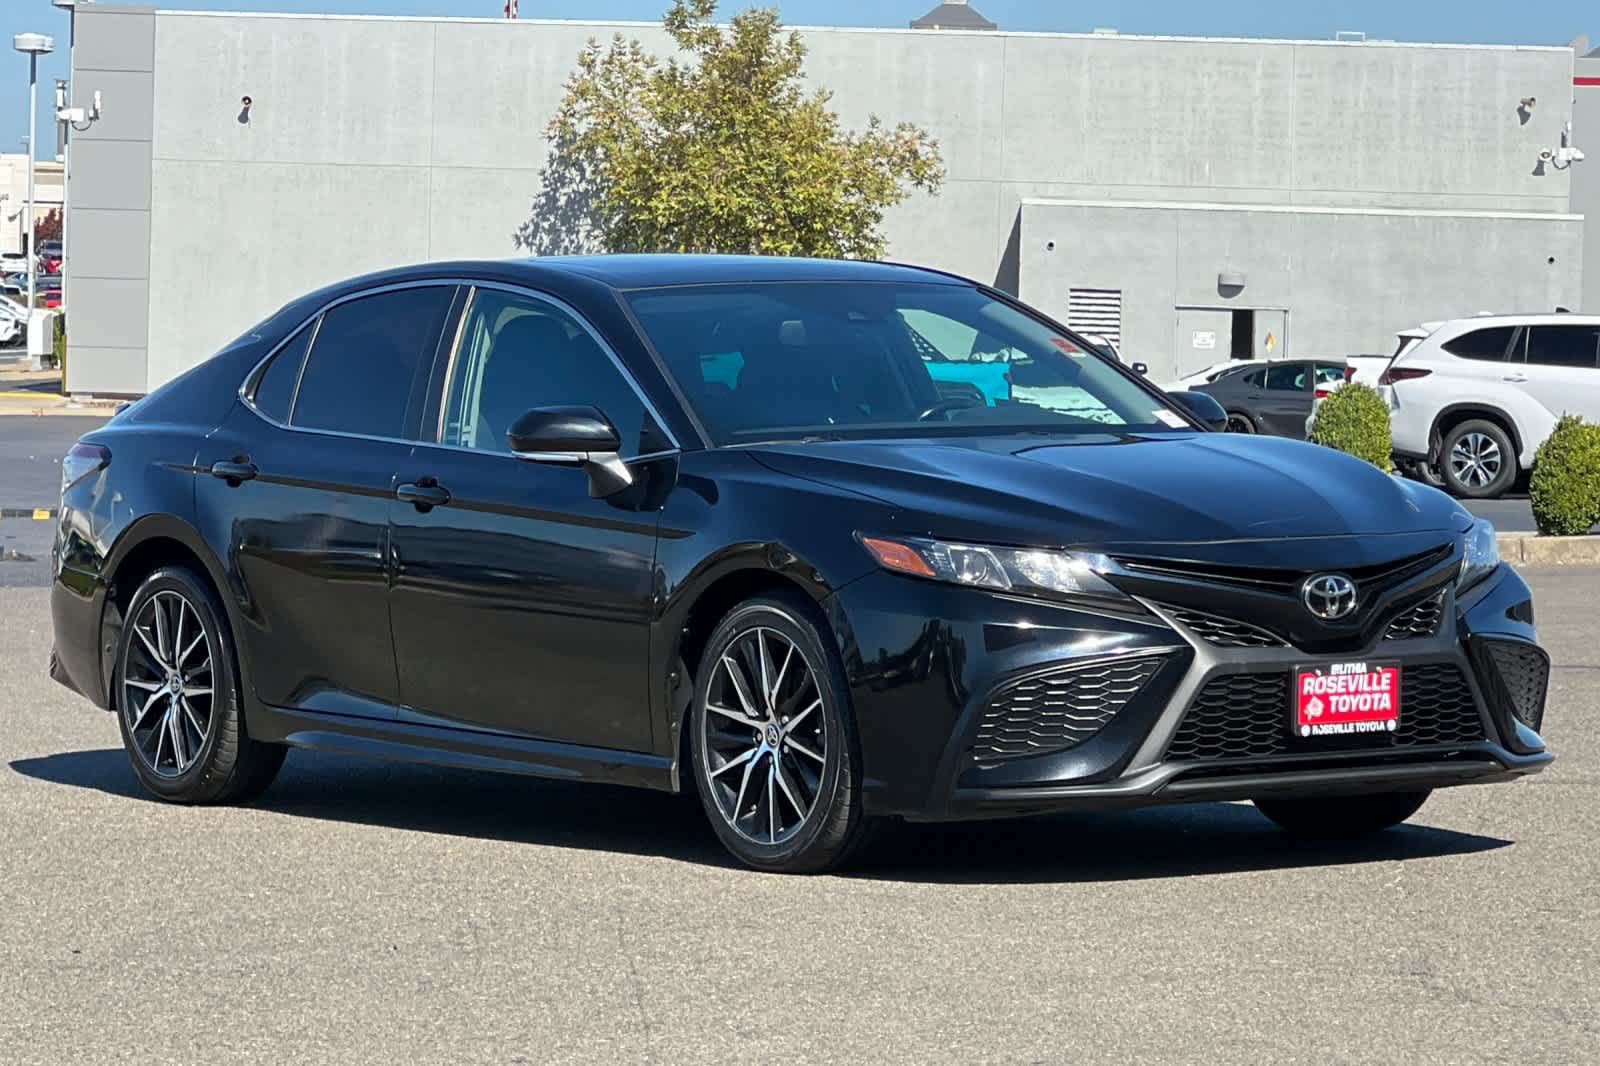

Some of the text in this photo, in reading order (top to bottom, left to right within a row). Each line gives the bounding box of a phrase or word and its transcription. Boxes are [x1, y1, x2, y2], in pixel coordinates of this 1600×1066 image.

[1303, 673, 1392, 695] ROSEVILLE
[1329, 693, 1391, 713] TOYOTA
[1312, 721, 1385, 735] ROSEVILLE TOYOTA
